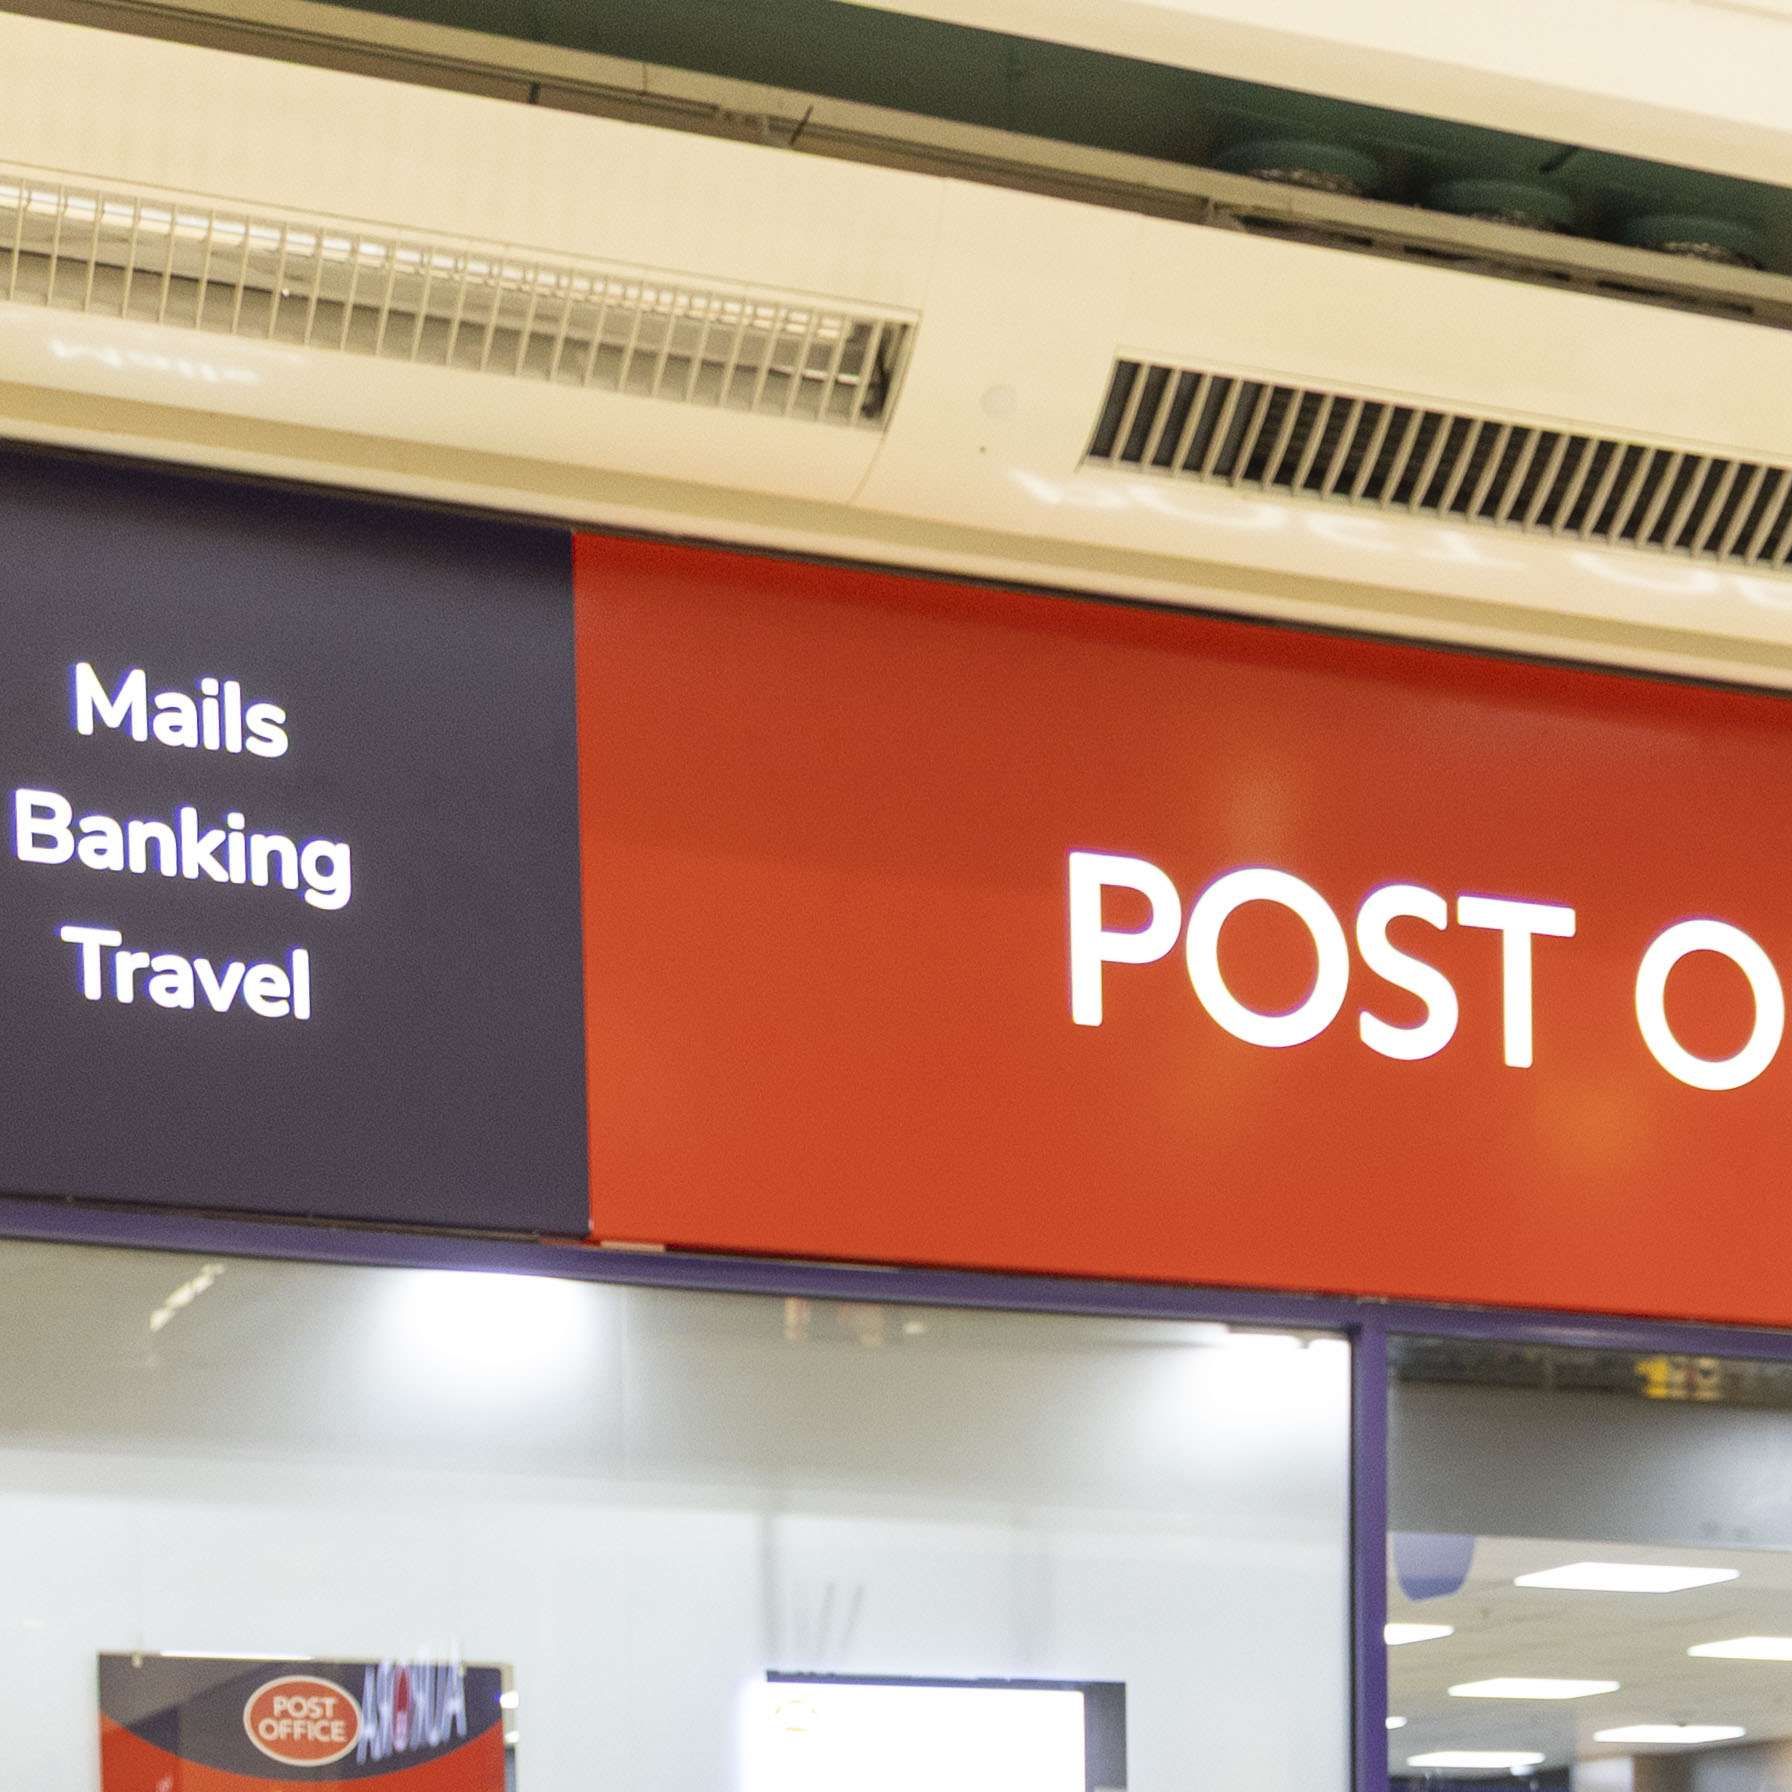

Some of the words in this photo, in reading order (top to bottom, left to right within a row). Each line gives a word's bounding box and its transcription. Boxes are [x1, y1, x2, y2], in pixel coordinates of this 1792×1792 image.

[76, 662, 288, 758] Mails
[14, 789, 352, 909] Banking
[61, 926, 310, 1020] Travel
[1068, 852, 1575, 1068] POST
[258, 1718, 347, 1742] OFFICE
[273, 1696, 335, 1719] POST
